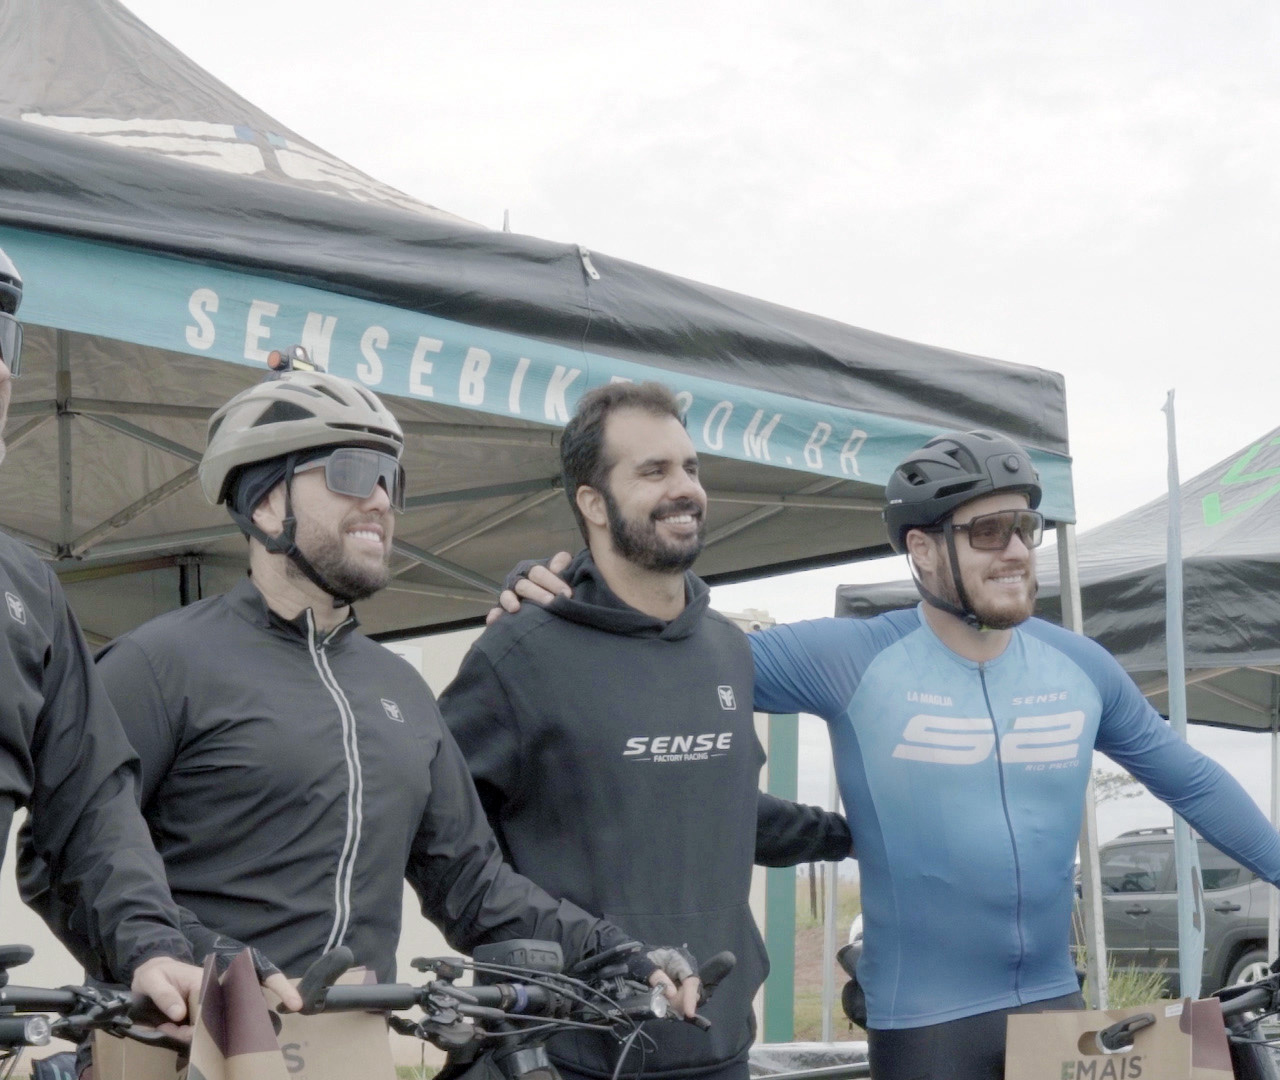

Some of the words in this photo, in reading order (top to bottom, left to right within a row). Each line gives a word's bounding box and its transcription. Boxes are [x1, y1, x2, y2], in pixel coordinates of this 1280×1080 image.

[907, 691, 919, 702] LA
[920, 693, 953, 707] MAGLIA
[1011, 691, 1068, 706] SENSE
[623, 732, 733, 755] SENSE
[683, 752, 709, 761] RACING
[1048, 760, 1080, 770] PRETO
